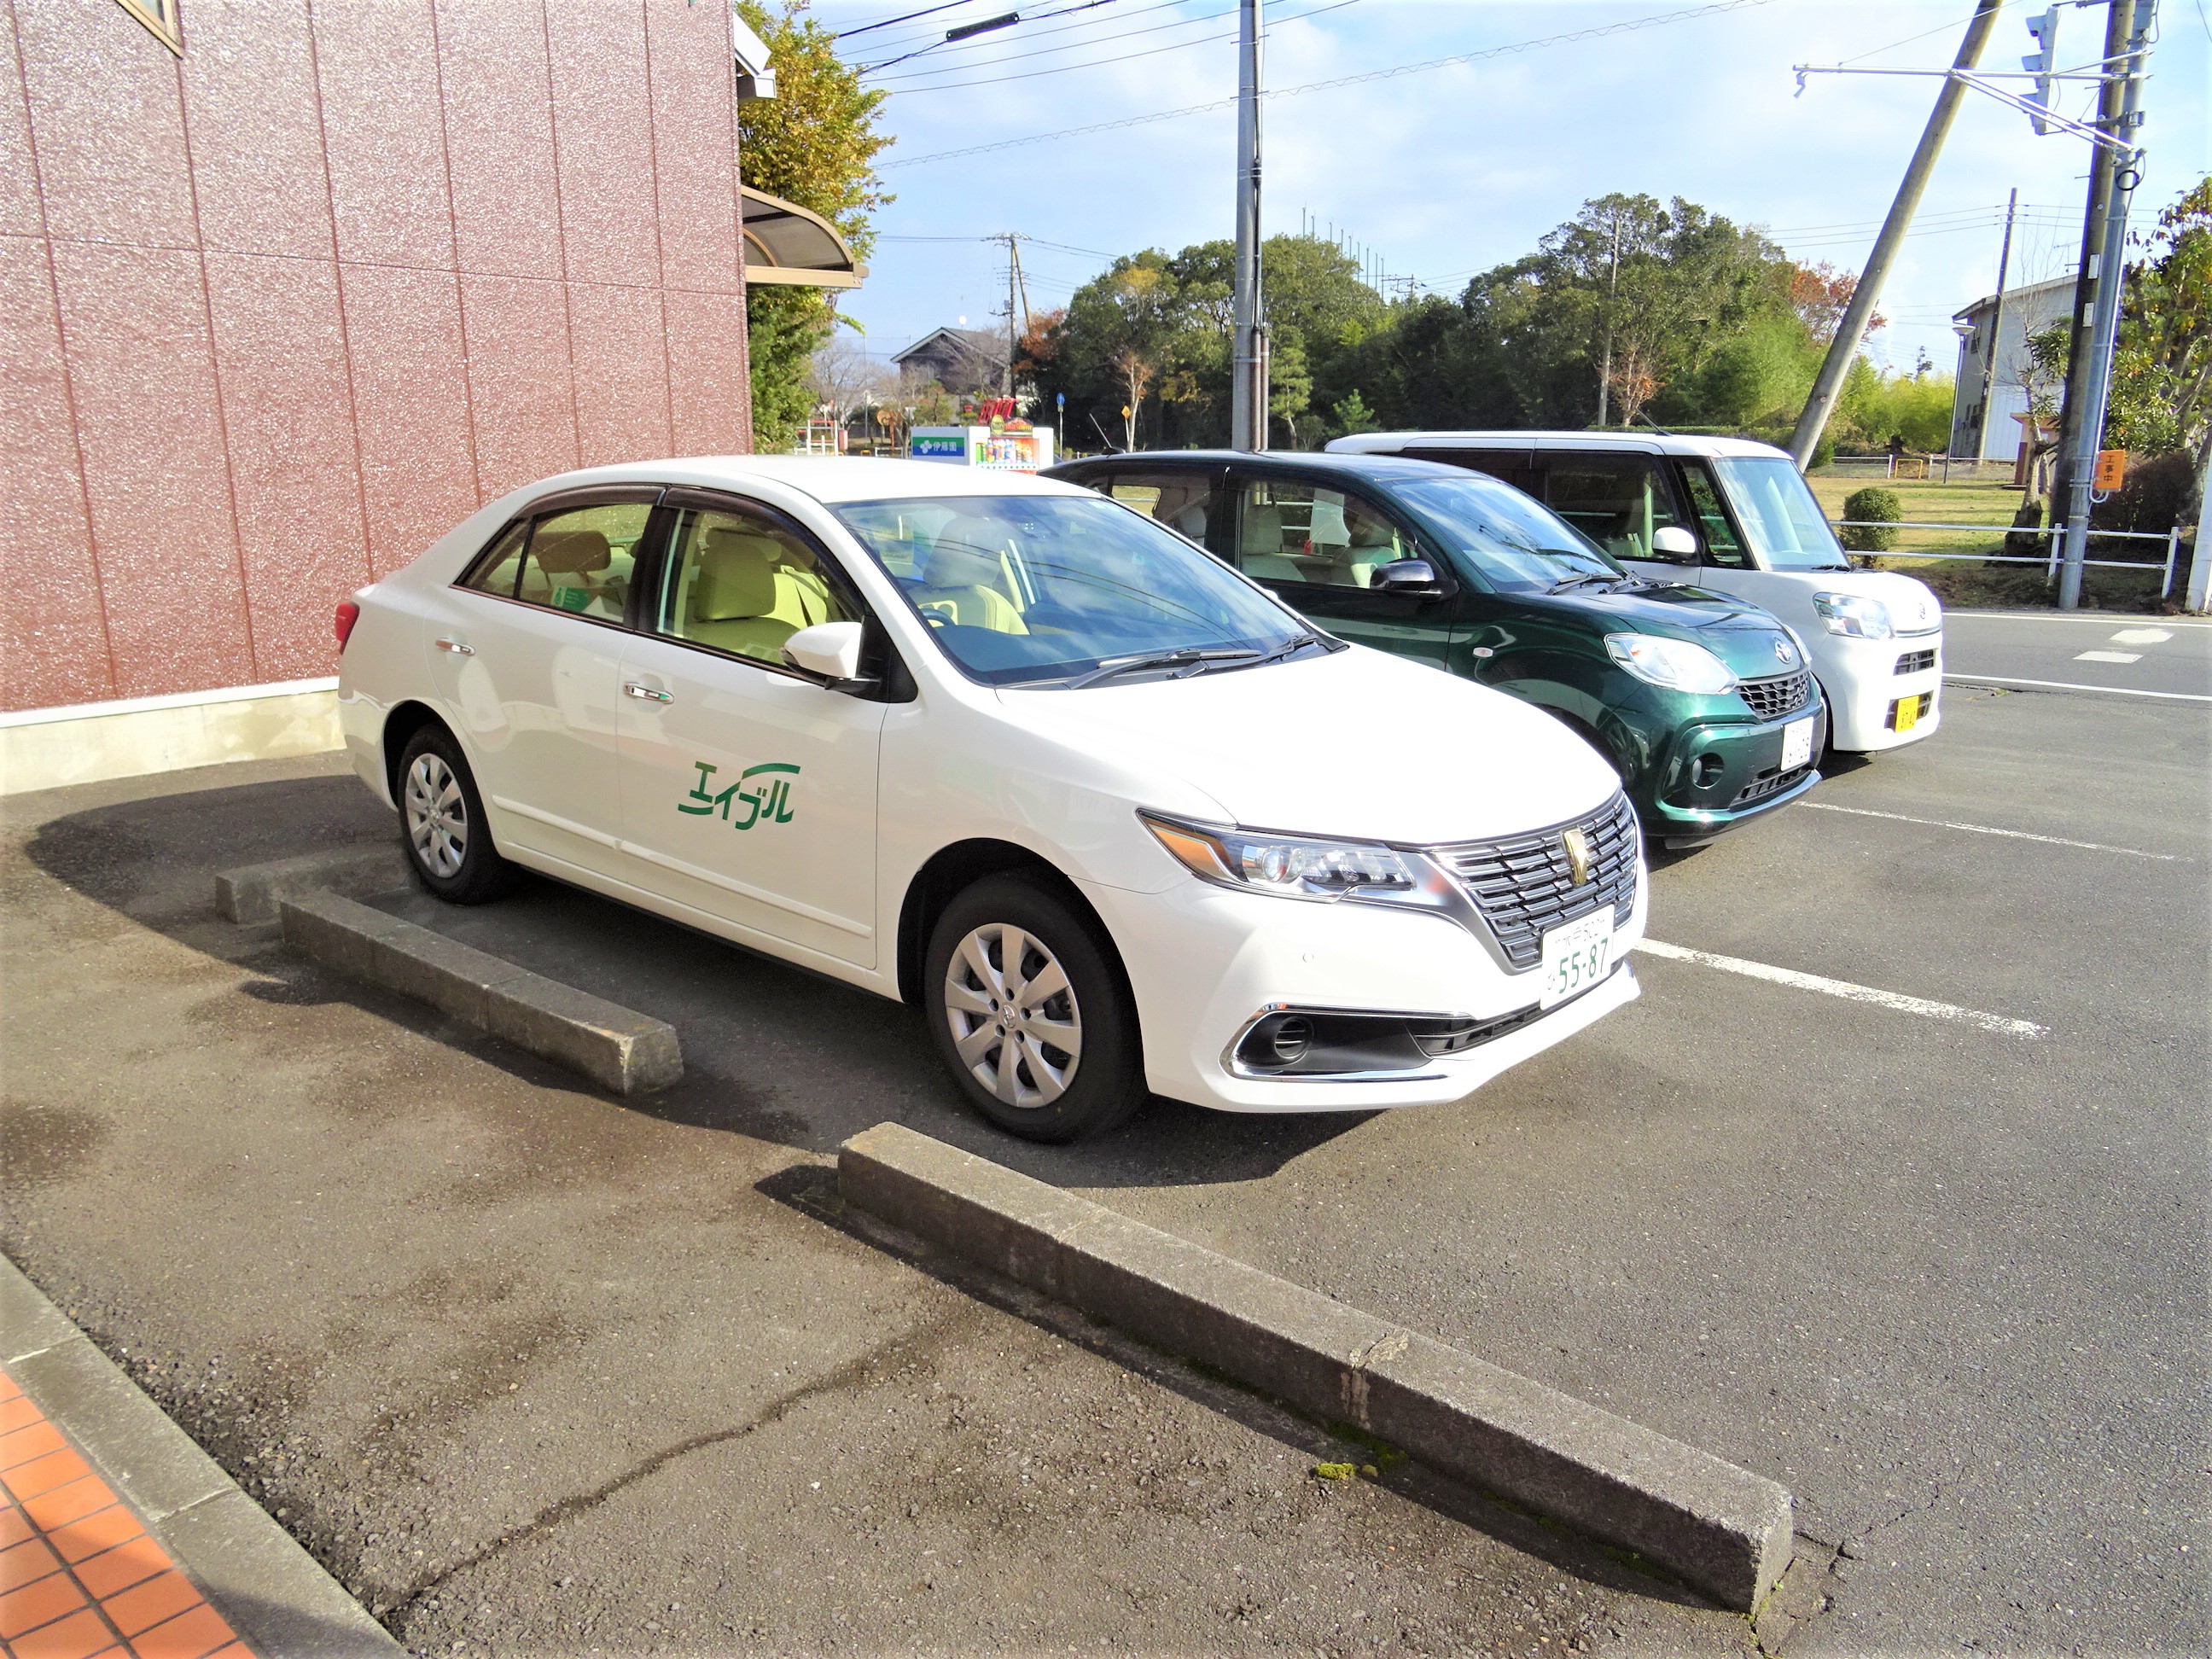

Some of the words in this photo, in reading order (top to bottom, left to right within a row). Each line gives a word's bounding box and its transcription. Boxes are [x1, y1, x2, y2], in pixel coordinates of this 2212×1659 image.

[934, 441, 957, 452] 伊藤園
[2104, 455, 2115, 482] 工事中
[678, 761, 801, 830] エイブル
[1558, 937, 1609, 994] 55-87
